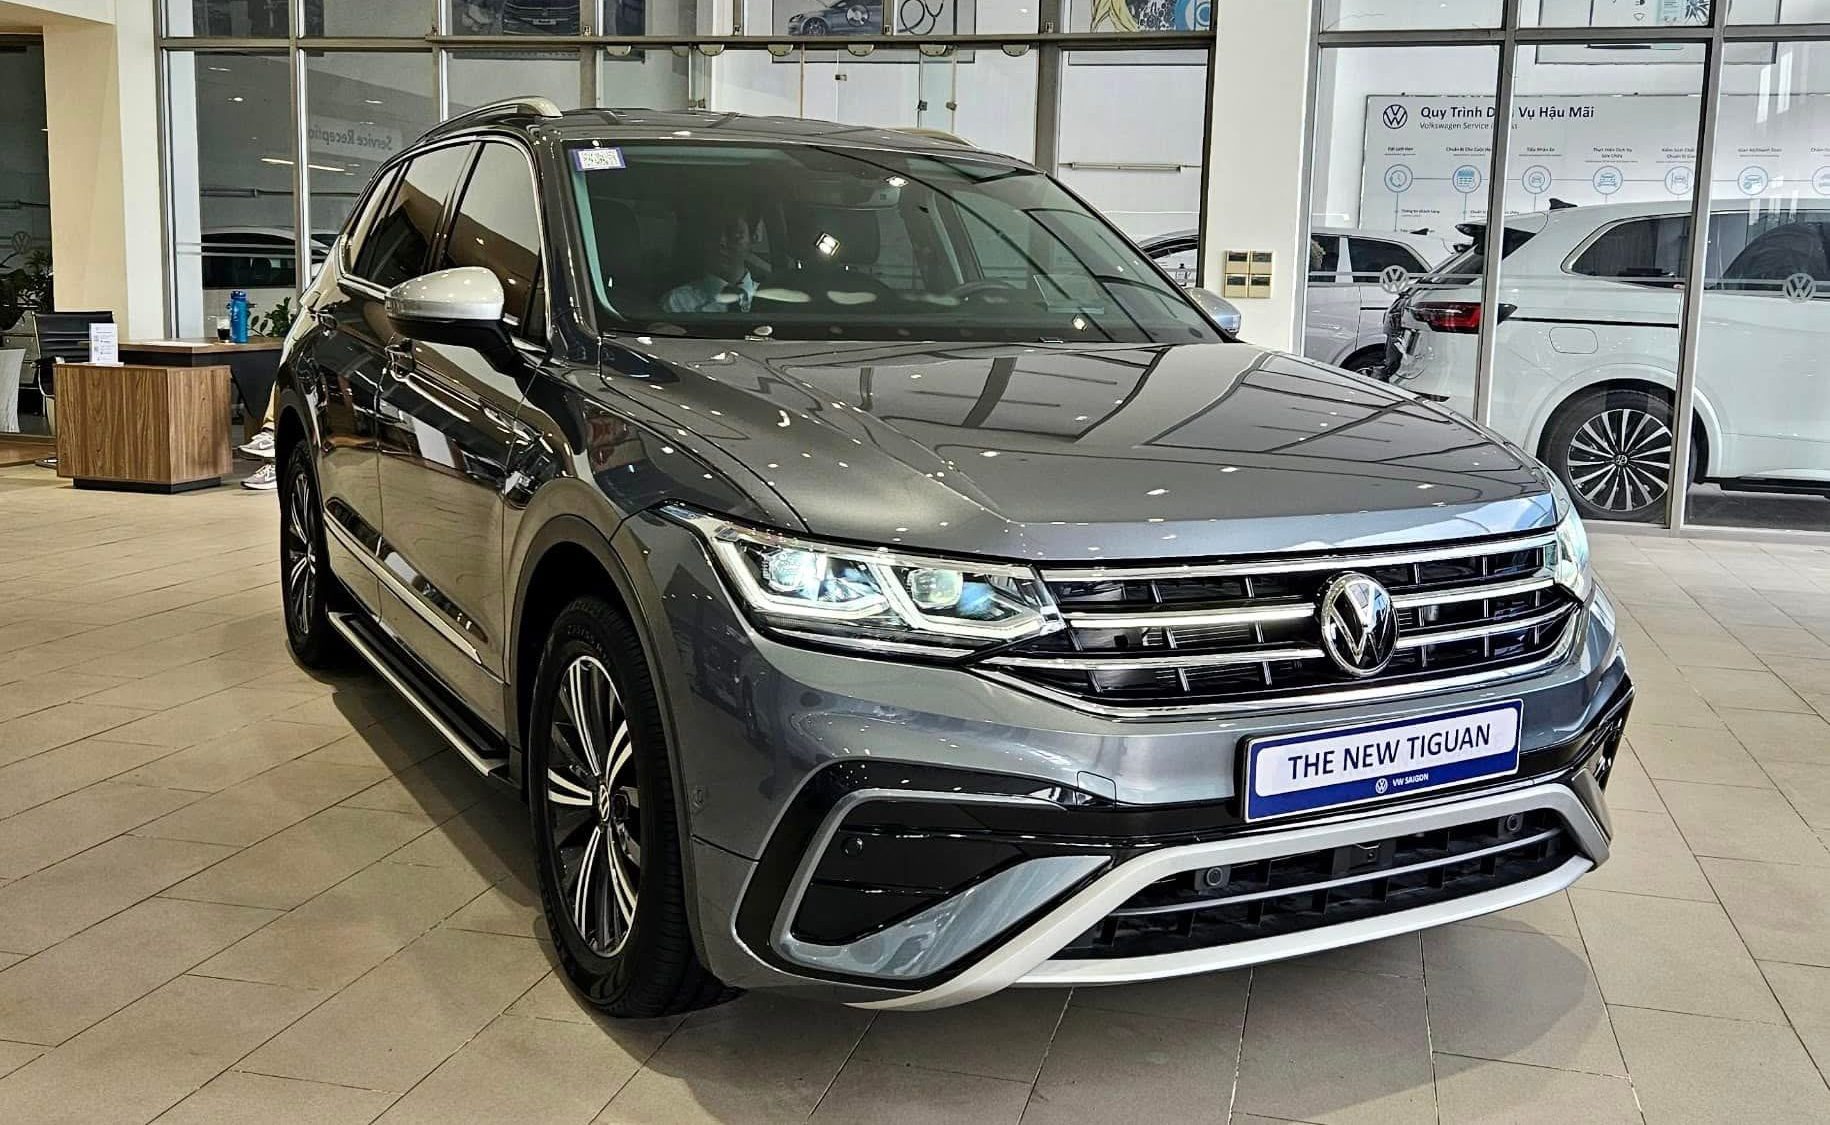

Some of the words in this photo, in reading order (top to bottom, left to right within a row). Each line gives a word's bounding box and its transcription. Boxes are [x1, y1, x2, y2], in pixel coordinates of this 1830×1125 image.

[1420, 106, 1446, 121] Quy
[1450, 106, 1482, 118] Trình
[1518, 106, 1535, 120] Vụ
[1539, 106, 1565, 120] Hậu
[1569, 106, 1595, 118] Mãi
[1420, 122, 1462, 131] Volkswagen
[1463, 122, 1489, 130] Service
[1287, 750, 1335, 780] THE
[1343, 739, 1400, 771] NEW
[1407, 723, 1491, 761] TIGUAN
[1392, 777, 1404, 787] VW
[1404, 773, 1429, 785] SAIGON
